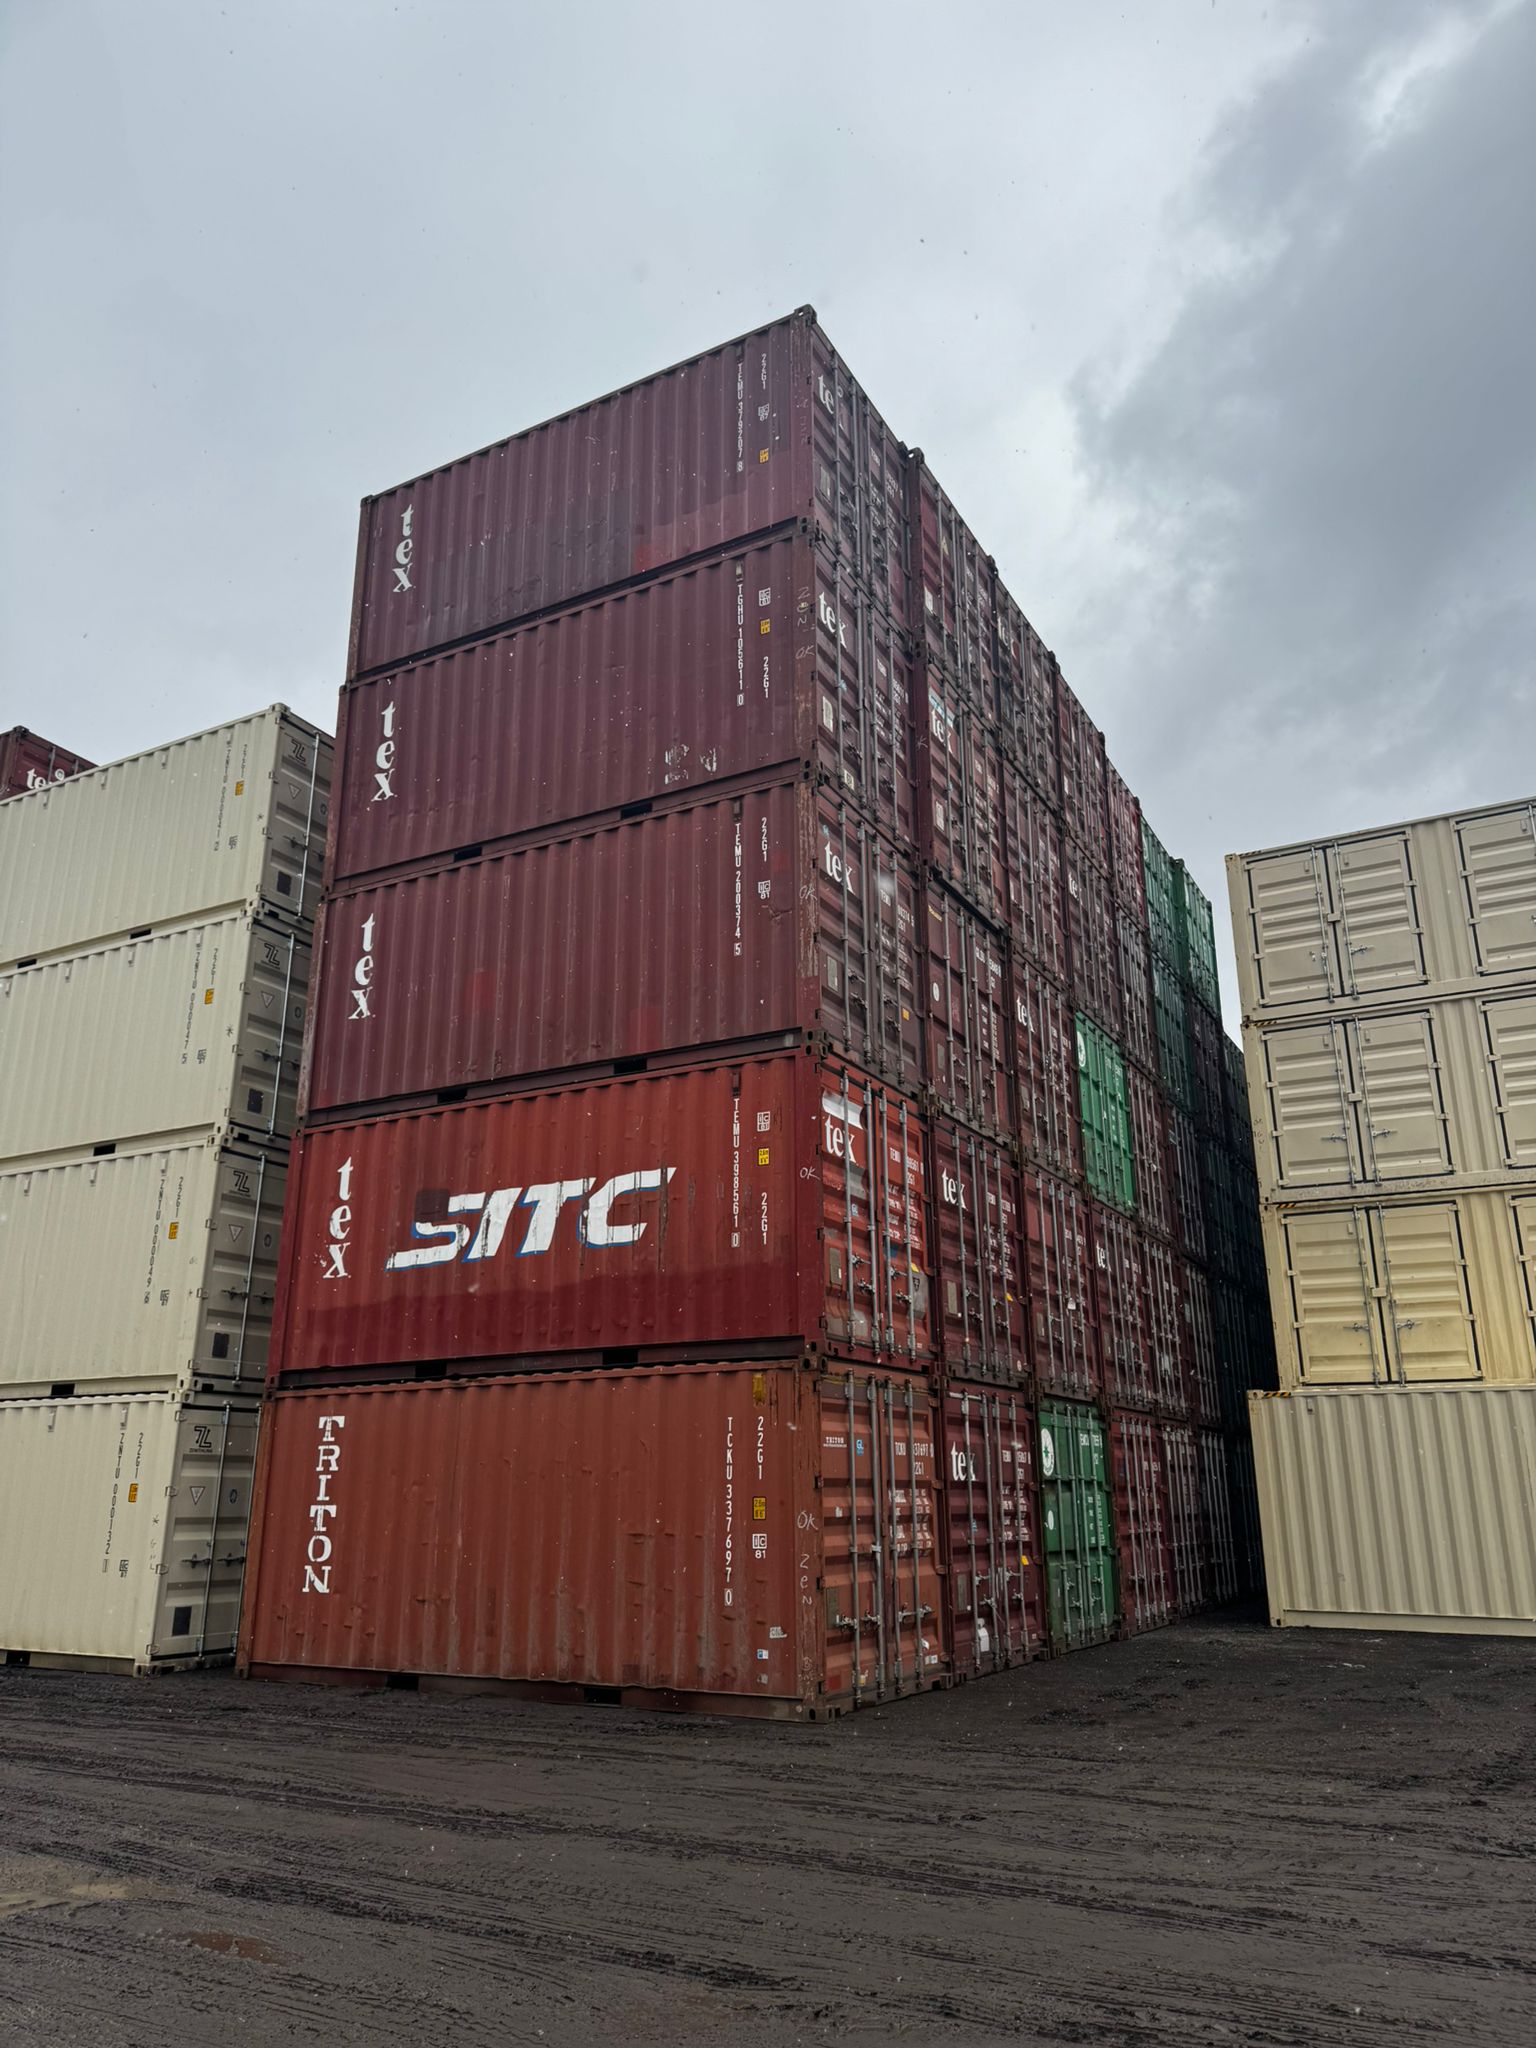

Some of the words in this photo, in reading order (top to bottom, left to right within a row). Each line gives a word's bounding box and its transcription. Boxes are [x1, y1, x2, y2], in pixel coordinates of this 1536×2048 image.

[392, 503, 415, 592] tex
[819, 591, 848, 649] tex
[737, 693, 744, 706] 0
[371, 700, 397, 801] tex
[734, 823, 742, 867] TEMU
[825, 841, 856, 896] tex
[348, 912, 376, 1020] tex
[734, 942, 741, 956] 5
[732, 1098, 740, 1148] TEMU
[825, 1115, 858, 1165] tex
[800, 1166, 820, 1181] OK
[942, 1168, 968, 1211] tex
[175, 1176, 184, 1218] 22G1
[323, 1156, 353, 1278] tex
[731, 1232, 740, 1247] 0
[114, 1433, 124, 1479] ZNTU
[134, 1432, 144, 1479] 22G1
[951, 1441, 978, 1481] tex
[105, 1484, 119, 1555] 000132
[302, 1416, 345, 1593] TRITON
[755, 1550, 766, 1559] 81
[724, 1588, 733, 1606] 0
